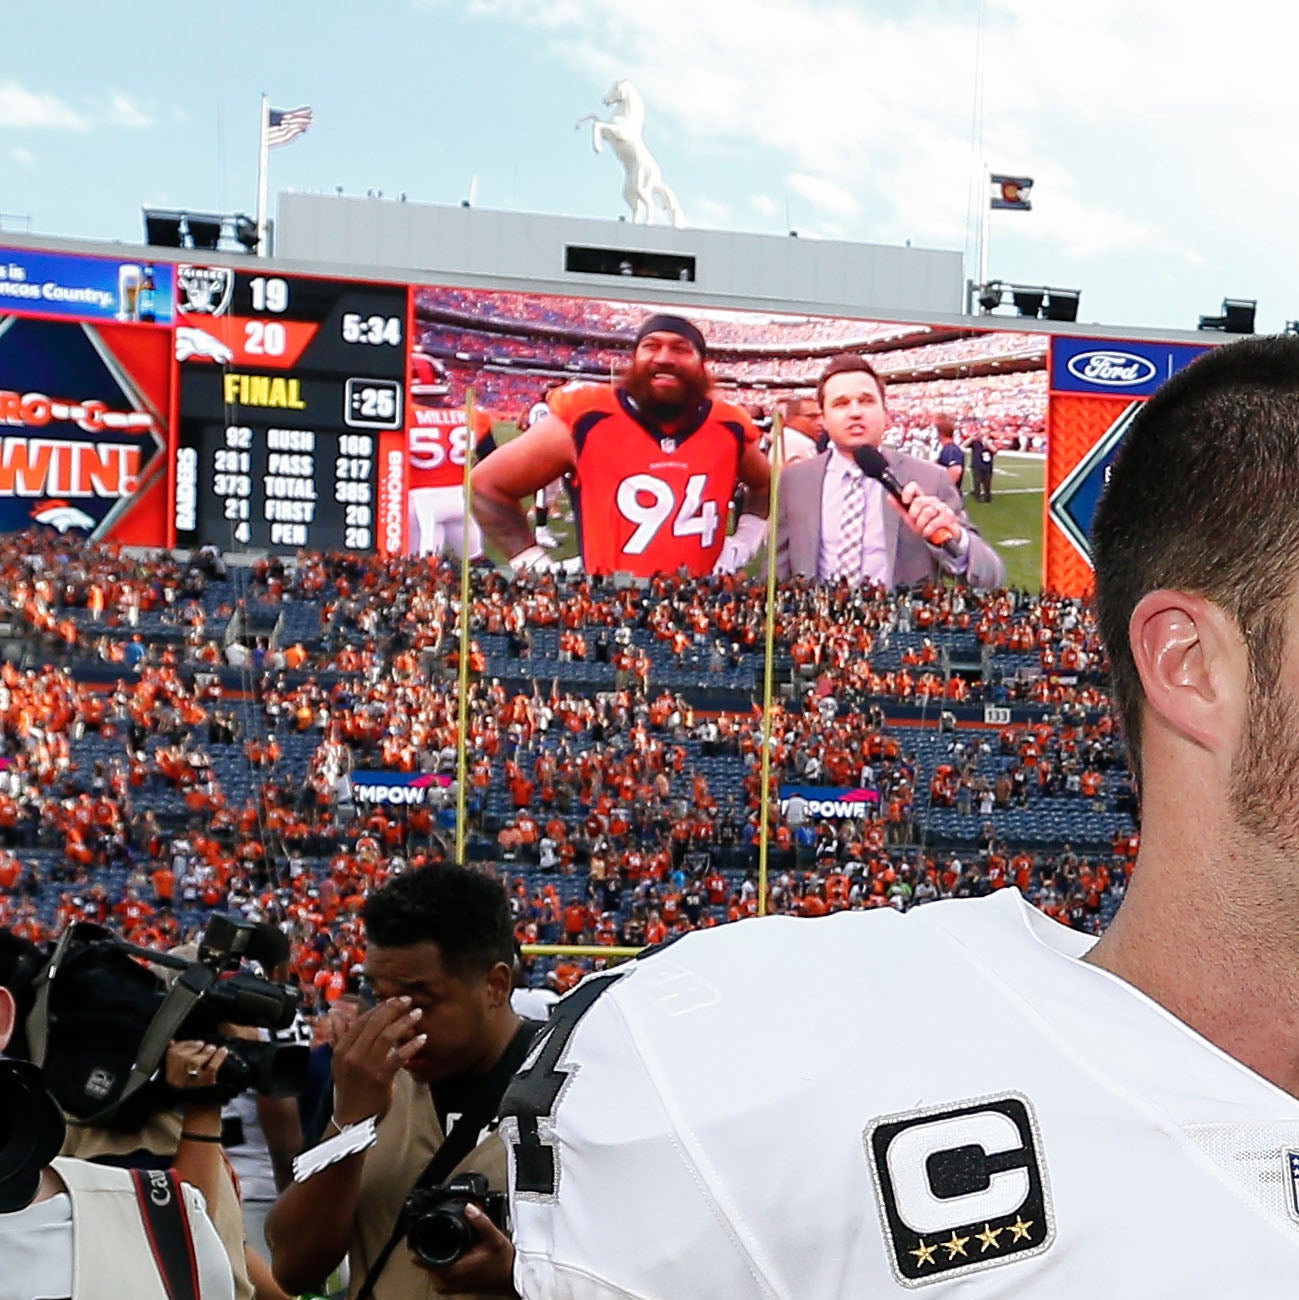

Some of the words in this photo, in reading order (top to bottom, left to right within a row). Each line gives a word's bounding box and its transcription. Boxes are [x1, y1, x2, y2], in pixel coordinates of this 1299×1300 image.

[250, 277, 289, 312] 19
[244, 321, 287, 356] 20
[343, 314, 402, 346] 5:34
[1085, 355, 1140, 381] Ford
[224, 373, 306, 409] FINAL
[415, 410, 466, 425] MILLER
[226, 426, 252, 448] 92
[267, 428, 315, 451] RUSH
[409, 426, 476, 469] 58
[268, 453, 314, 476] PASS
[336, 458, 372, 479] 217
[176, 447, 197, 531] RAIDERS
[213, 474, 251, 496] 373
[263, 476, 318, 499] TOTAL
[386, 451, 403, 553] BRONCOS
[224, 499, 250, 520] 21
[264, 500, 315, 523] FIRST
[346, 505, 371, 527] 20
[617, 473, 719, 555] 94
[235, 522, 251, 543] 4
[271, 523, 307, 545] PEN
[345, 527, 371, 549] 20
[887, 1110, 1032, 1234] C
